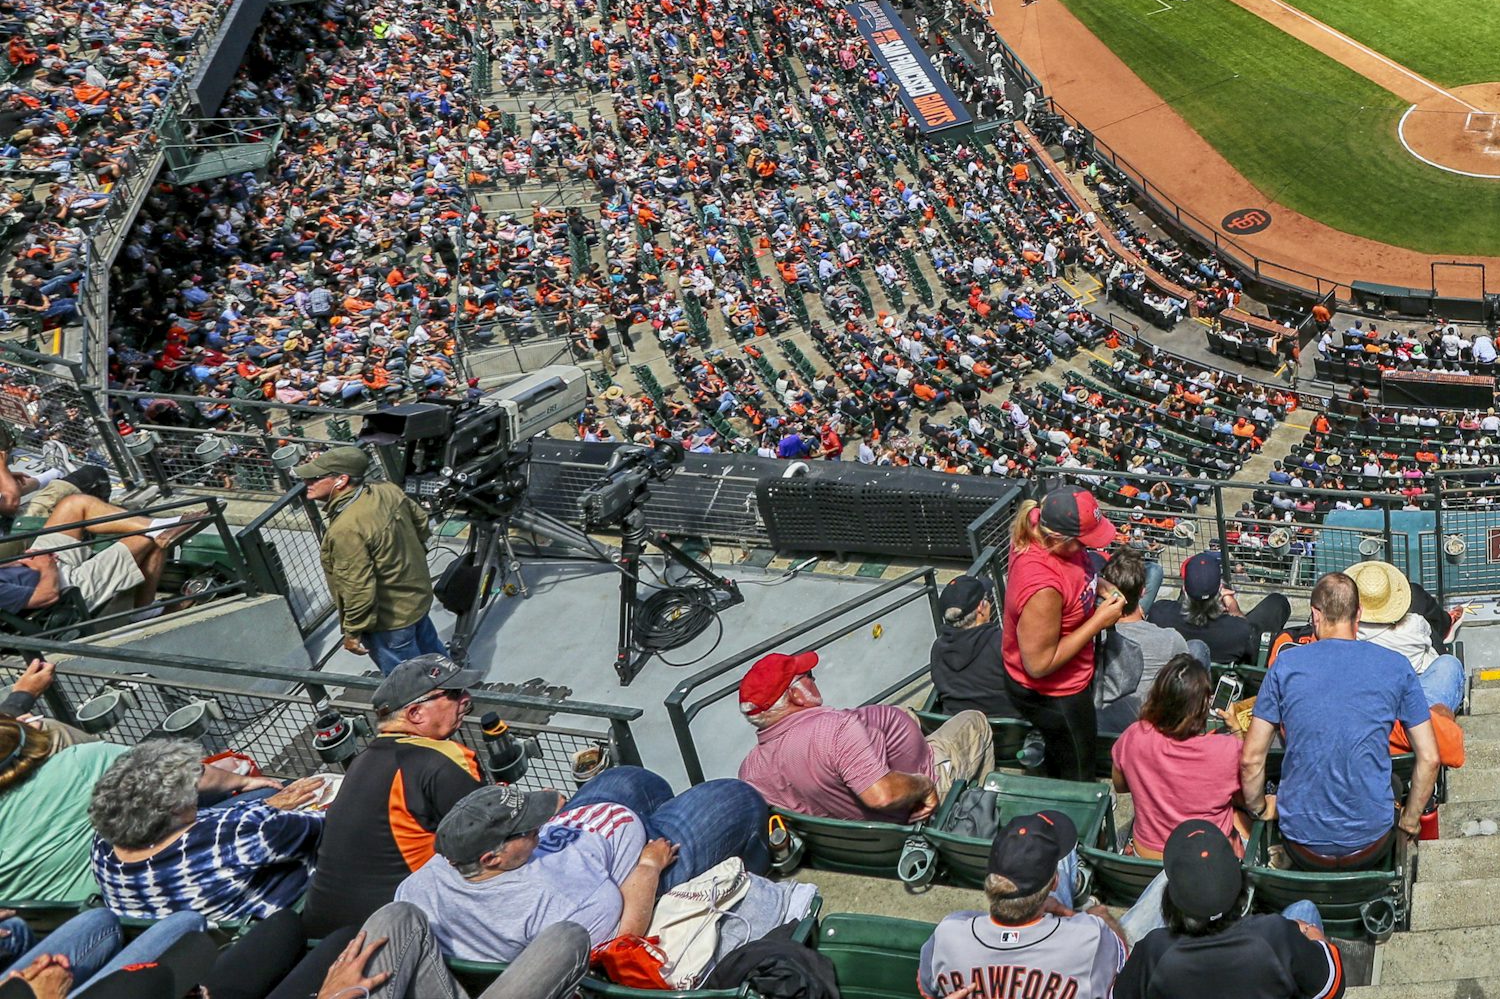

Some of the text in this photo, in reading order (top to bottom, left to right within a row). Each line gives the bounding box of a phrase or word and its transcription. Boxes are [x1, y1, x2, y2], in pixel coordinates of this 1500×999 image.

[912, 92, 958, 127] GIANTS
[1298, 393, 1321, 405] blue
[936, 964, 1080, 999] CRAWFORD
